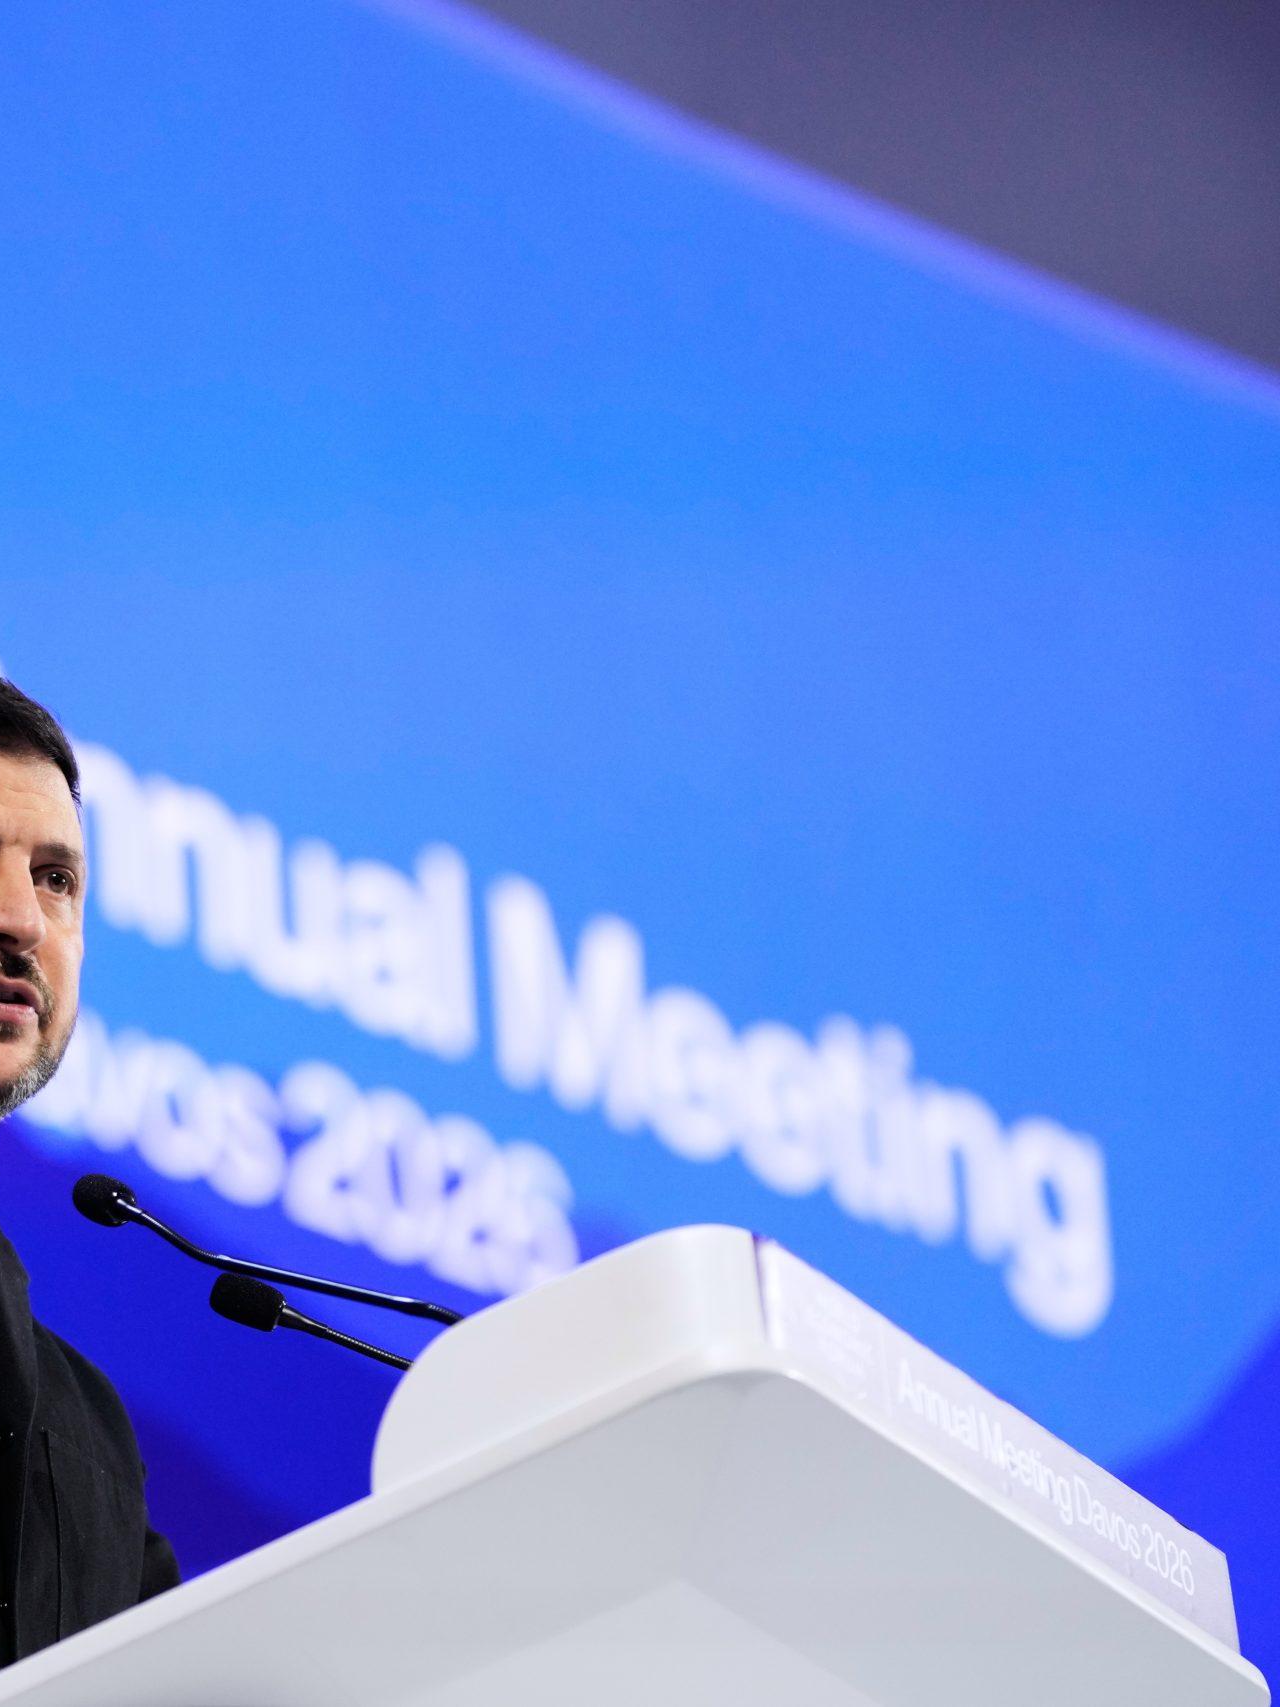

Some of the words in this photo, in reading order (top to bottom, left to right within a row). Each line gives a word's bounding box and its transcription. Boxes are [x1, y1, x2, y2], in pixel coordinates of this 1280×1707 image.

[280, 1059, 580, 1299] 2026
[486, 872, 1115, 1340] Meeting
[897, 1357, 979, 1452] Annual
[977, 1410, 1074, 1526] Meeting
[1072, 1474, 1142, 1560] Davos
[1139, 1522, 1196, 1596] 2026
